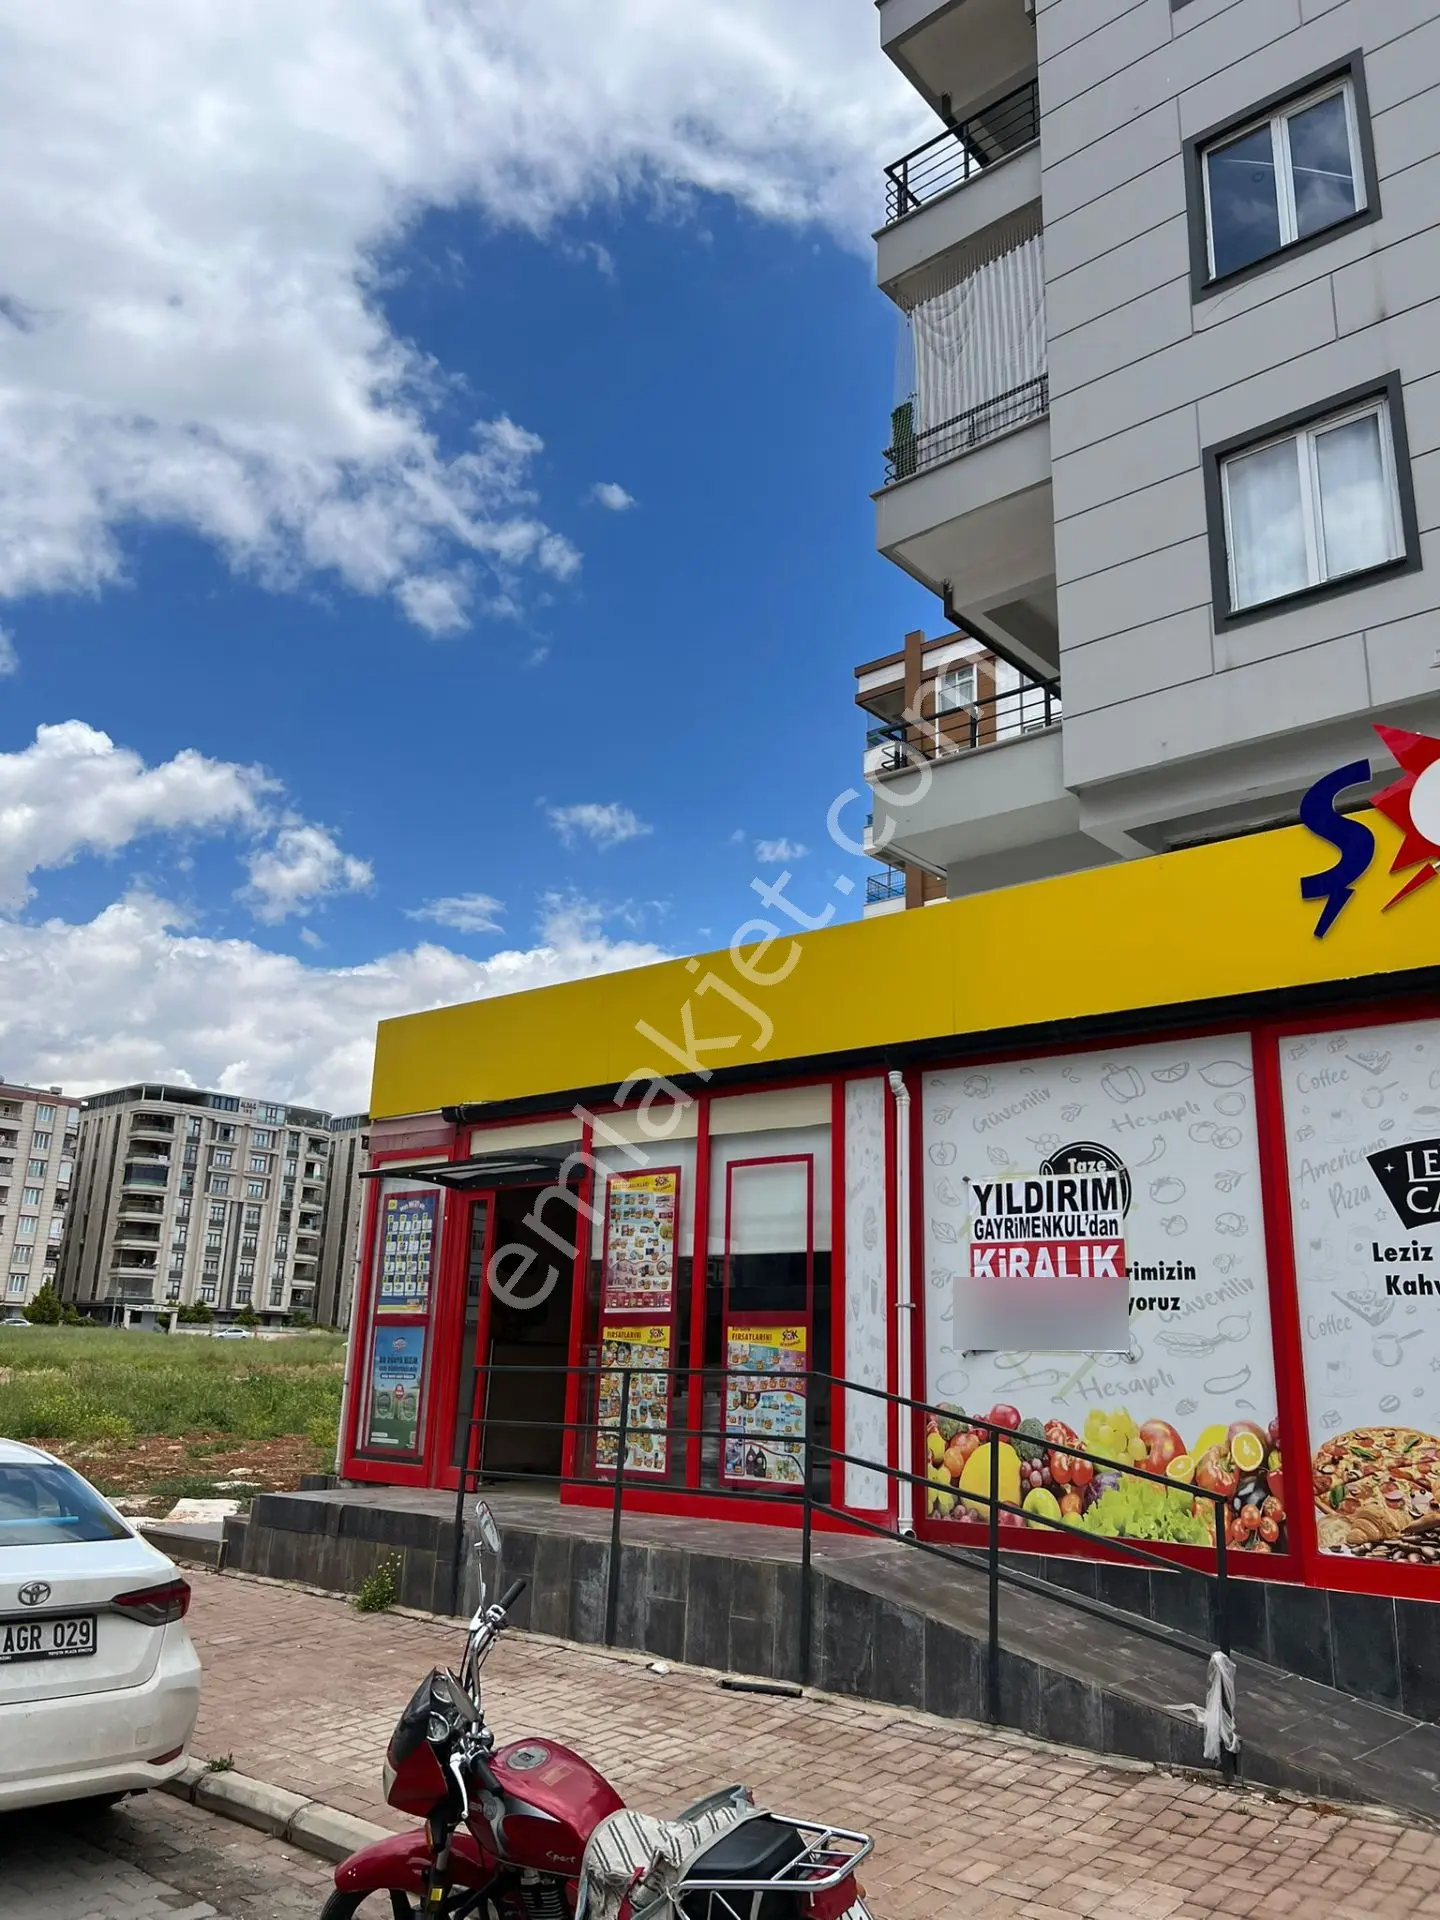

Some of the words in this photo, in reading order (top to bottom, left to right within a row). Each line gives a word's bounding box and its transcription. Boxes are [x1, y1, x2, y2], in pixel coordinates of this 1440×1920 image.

[1296, 1067, 1349, 1093] Coffee
[1068, 1158, 1107, 1174] Taze
[1296, 1138, 1387, 1186] Americano
[973, 1177, 1118, 1216] YILDIRIM
[1328, 1181, 1371, 1218] Pizza
[1372, 1240, 1433, 1262] Leziz
[1126, 1260, 1196, 1280] rimizin
[1129, 1297, 1180, 1316] yoruz
[1307, 1314, 1352, 1340] Coffee
[3, 1625, 41, 1652] AGR
[53, 1620, 90, 1648] 029
